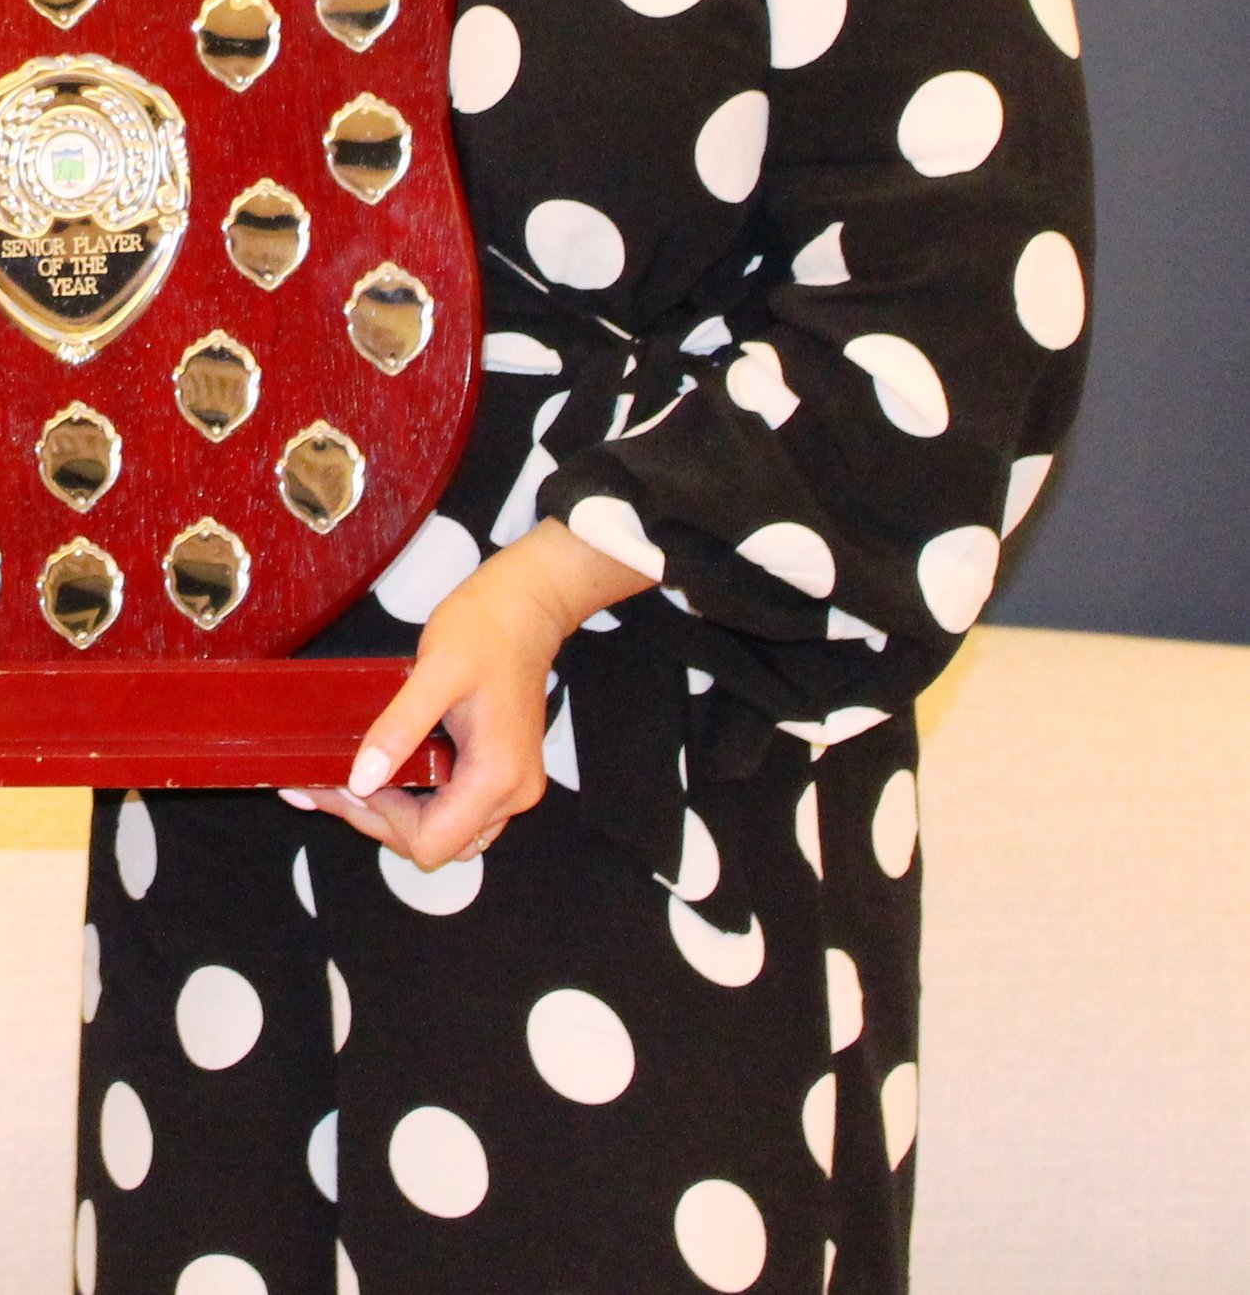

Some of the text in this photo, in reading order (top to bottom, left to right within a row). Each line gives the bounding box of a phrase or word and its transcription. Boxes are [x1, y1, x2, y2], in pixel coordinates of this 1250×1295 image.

[1, 234, 144, 258] SENIOR PLAYER
[38, 256, 108, 277] OF THE
[47, 277, 98, 297] YEAR
